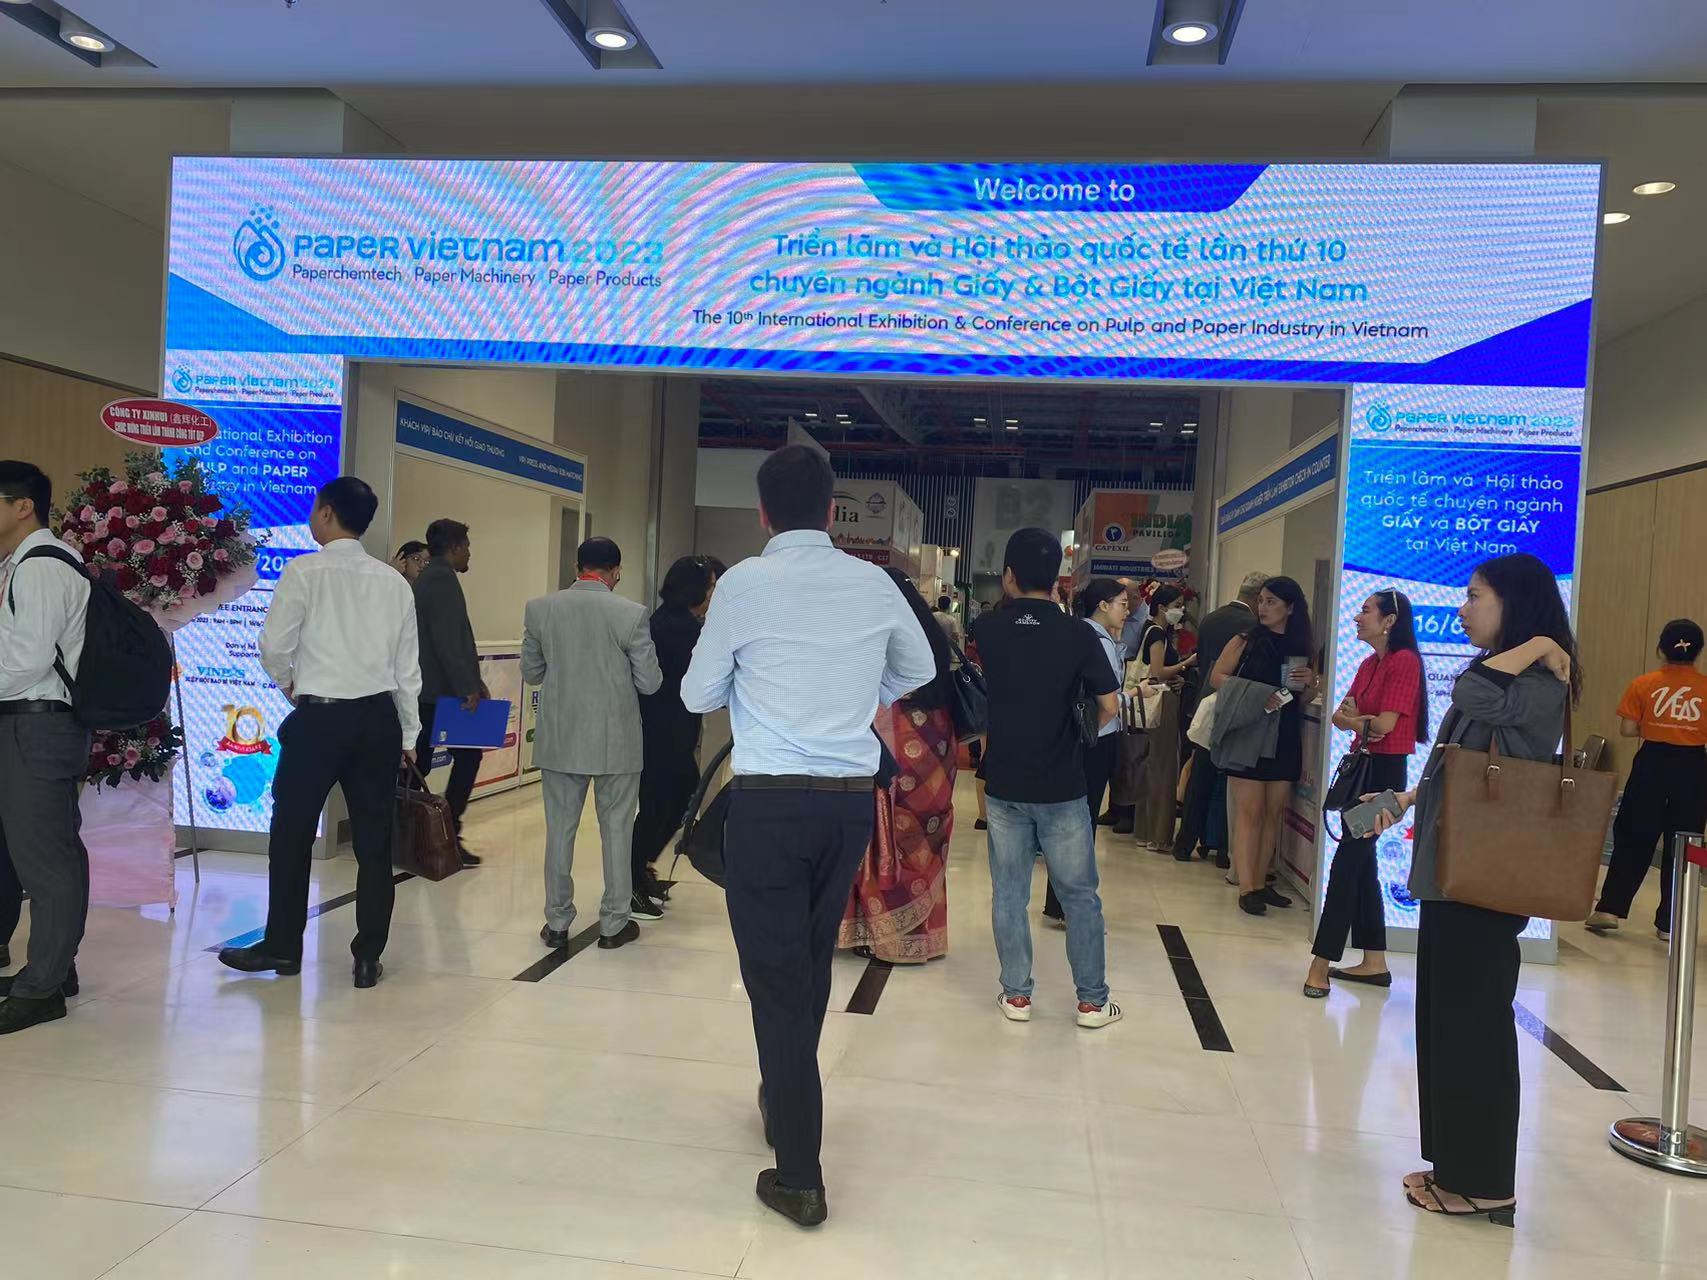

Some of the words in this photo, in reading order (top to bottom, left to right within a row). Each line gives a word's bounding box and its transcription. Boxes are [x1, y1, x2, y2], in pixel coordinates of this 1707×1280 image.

[974, 177, 1100, 201] Welcome
[1108, 178, 1136, 202] to
[570, 239, 664, 266] 2023
[773, 227, 837, 257] Triển
[846, 232, 900, 258] lãm
[909, 235, 943, 258] và
[950, 234, 996, 266] Hội
[1004, 234, 1072, 260] thảo
[1080, 231, 1152, 267] quốc
[1161, 231, 1192, 261] tế
[1199, 231, 1247, 262] lần
[1256, 236, 1304, 263] thứ
[1316, 239, 1346, 262] 10
[292, 263, 402, 282] Paperchemtech
[415, 266, 457, 285] Paper
[460, 267, 536, 289] Machinery
[548, 269, 592, 288] Paper
[596, 270, 662, 287] Products
[750, 269, 847, 298] chuyên
[855, 270, 943, 299] ngành
[953, 267, 1014, 301] Giấy
[1024, 276, 1043, 298] &
[1053, 273, 1101, 304] Bột
[1109, 270, 1174, 302] Giấy
[1183, 276, 1220, 306] tại
[1230, 276, 1287, 308] Việt
[1295, 278, 1369, 302] Nam
[693, 309, 722, 325] The
[726, 310, 754, 325] 10th
[757, 311, 863, 328] International
[868, 312, 949, 330] Exhibition
[954, 315, 966, 331] &
[972, 314, 1071, 332] Conference
[1077, 319, 1100, 333] on
[1105, 317, 1146, 337] Pulp
[1151, 318, 1186, 335] and
[1192, 319, 1247, 338] Paper
[1251, 319, 1325, 340] Industry
[1329, 320, 1346, 336] in
[1351, 321, 1430, 339] Vietnam
[241, 387, 260, 396] Paper
[260, 388, 288, 397] Machinery
[292, 390, 308, 398] Paper
[309, 390, 334, 398] Products
[131, 408, 141, 419] TY
[266, 429, 334, 444] Exhibition
[1453, 426, 1475, 435] Paper
[1475, 426, 1514, 437] Machinery
[1517, 428, 1539, 437] Paper
[1540, 428, 1574, 437] Products
[215, 444, 295, 460] Conference
[298, 449, 317, 460] on
[231, 462, 259, 476] and
[262, 464, 309, 478] PAPER
[243, 480, 256, 492] in
[259, 480, 318, 495] Vietnam
[1453, 472, 1474, 487] và
[1485, 474, 1516, 492] Hội
[1520, 474, 1564, 490] thảo
[1360, 487, 1404, 508] quốc
[1410, 490, 1429, 507] tế
[1434, 492, 1499, 513] chuyên
[1504, 497, 1564, 515] ngành
[1382, 508, 1424, 529] GIẤY
[1429, 514, 1449, 530] và
[1455, 513, 1493, 538] BỘT
[1497, 512, 1541, 534] GIẤY
[1095, 543, 1130, 552] CAPEXIL
[1405, 537, 1429, 554] tại
[1434, 537, 1469, 555] Việt
[1474, 540, 1518, 555] Nam
[231, 605, 270, 613] ENTRANC
